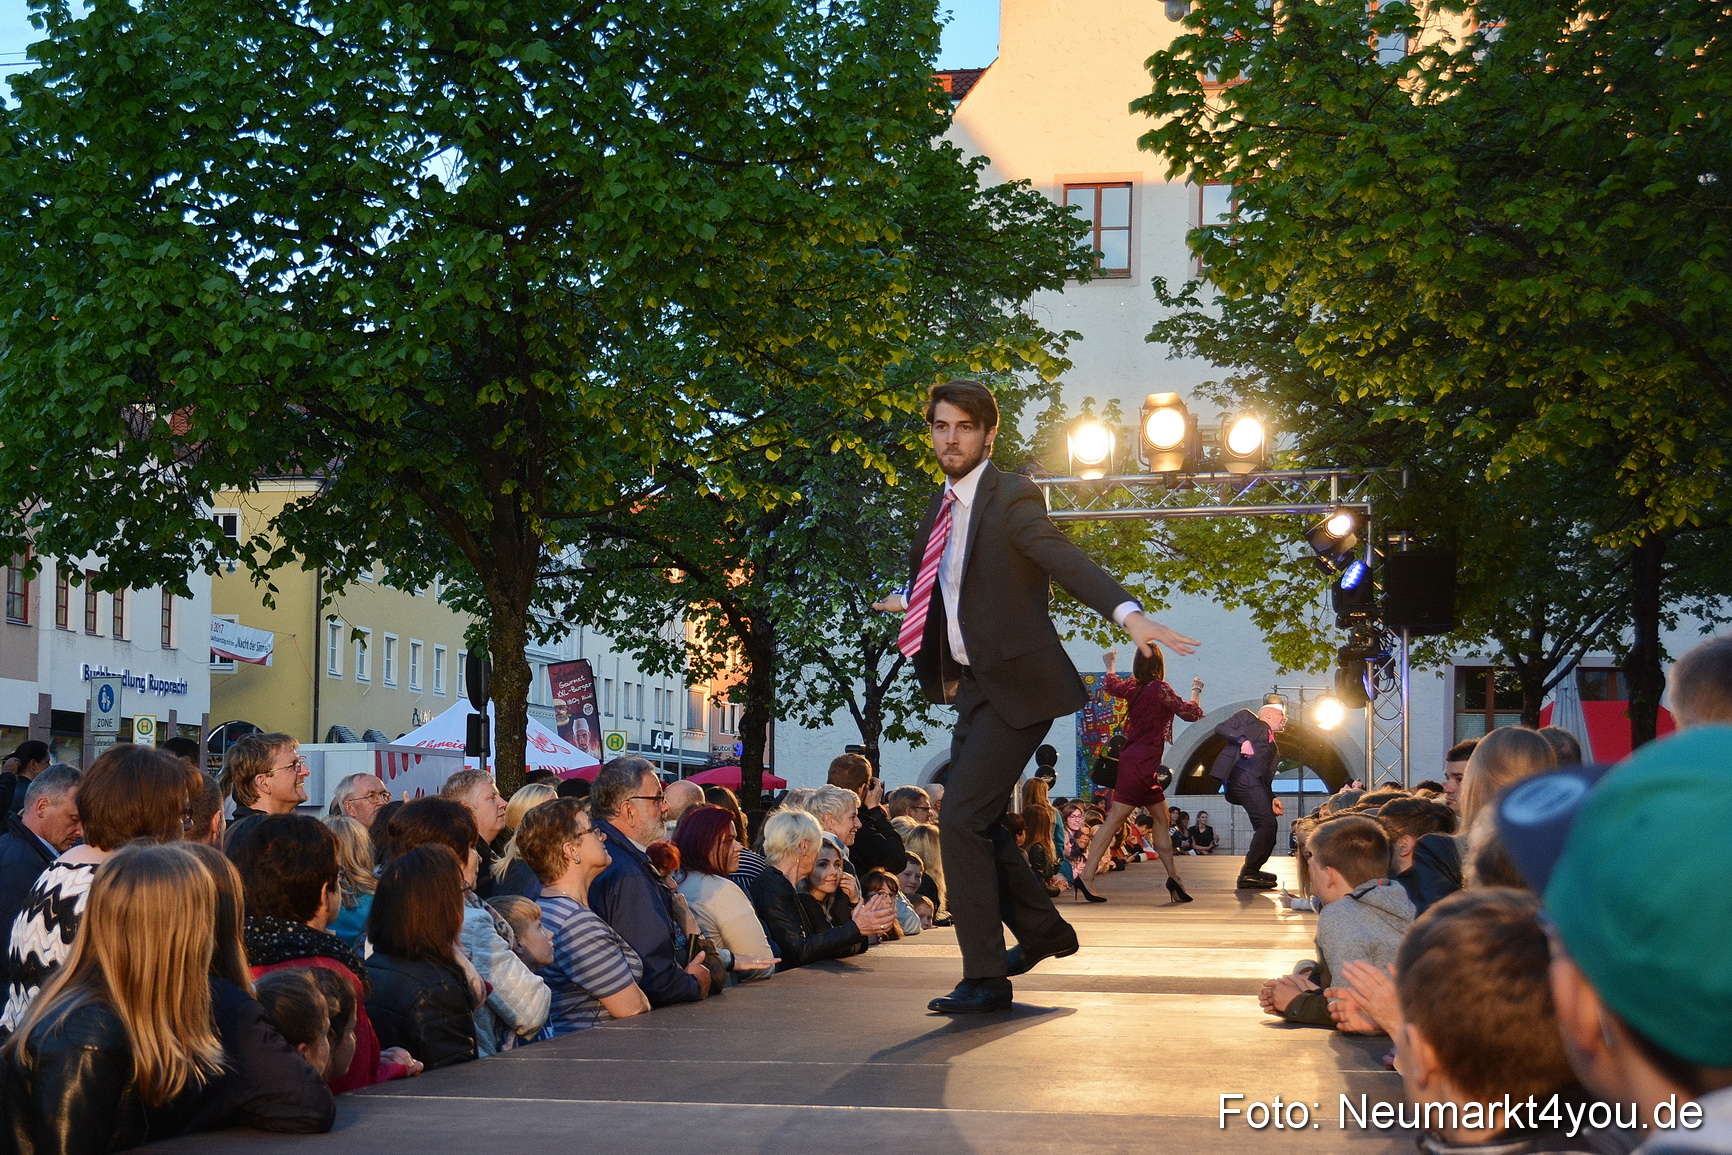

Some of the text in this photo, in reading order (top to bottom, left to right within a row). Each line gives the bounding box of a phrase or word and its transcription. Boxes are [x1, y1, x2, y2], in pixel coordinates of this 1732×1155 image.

[213, 621, 224, 634] 2017
[146, 672, 188, 697] Rupprecht
[558, 674, 586, 689] Gourmet
[557, 682, 592, 698] XXL-Burger
[97, 718, 113, 728] ZONE
[141, 721, 149, 732] H
[610, 737, 620, 748] H
